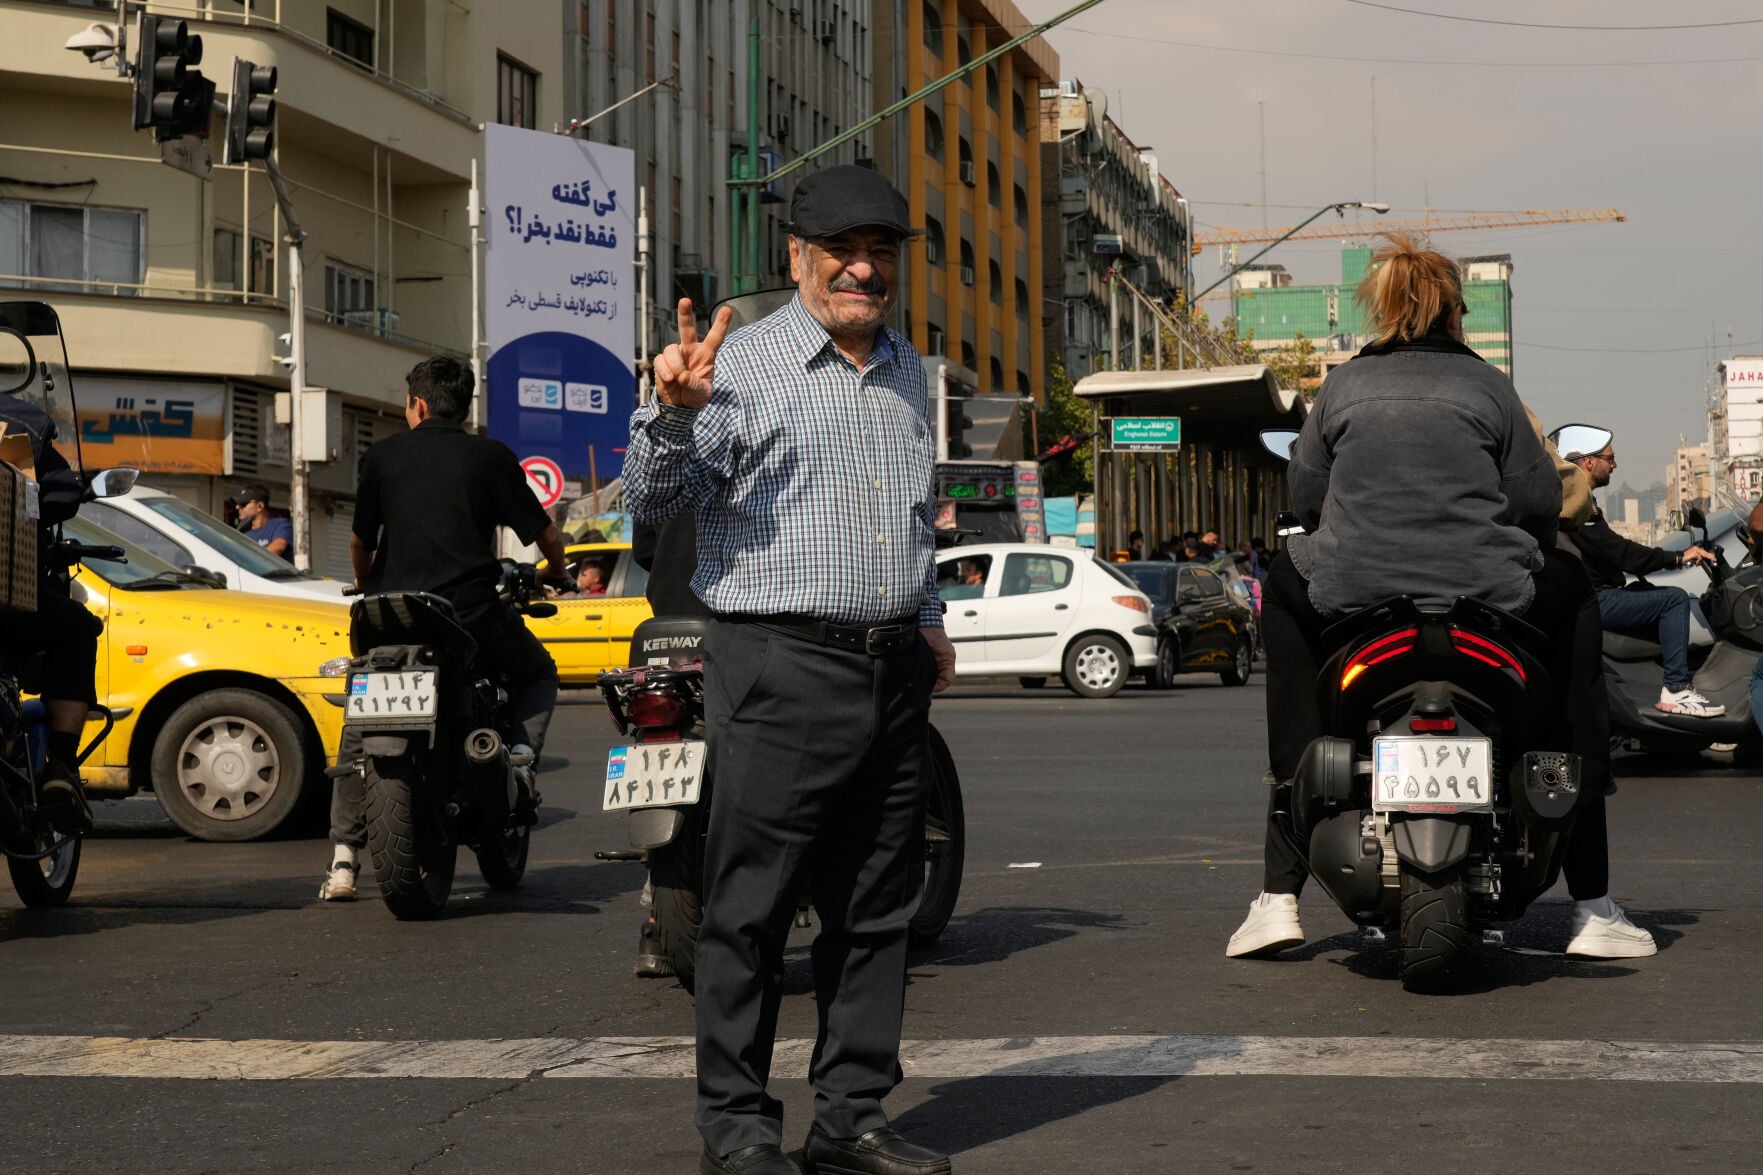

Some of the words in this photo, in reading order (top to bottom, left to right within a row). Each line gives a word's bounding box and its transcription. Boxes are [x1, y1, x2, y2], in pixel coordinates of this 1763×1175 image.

[552, 180, 591, 207] گفته
[593, 189, 617, 217] کی
[554, 219, 582, 243] نقد
[584, 223, 617, 249] فقط
[570, 269, 609, 288] تکنوپی
[610, 270, 618, 290] با
[506, 289, 526, 310] بخر
[528, 290, 561, 311] قسطی
[563, 295, 607, 317] تکنولایف
[607, 301, 617, 321] از
[82, 397, 195, 444] کفش
[1116, 422, 1141, 431] اسلامی
[642, 636, 703, 652] KEEWAY
[383, 673, 423, 691] ۱۱۴
[354, 696, 430, 712] ۹۱۳۹۲
[642, 747, 688, 771] ۱۴۸
[1418, 745, 1472, 768] ۱۶۷
[608, 776, 695, 805] ۸۴۱۴۳
[1383, 775, 1481, 799] ۴۵۵۹۹
